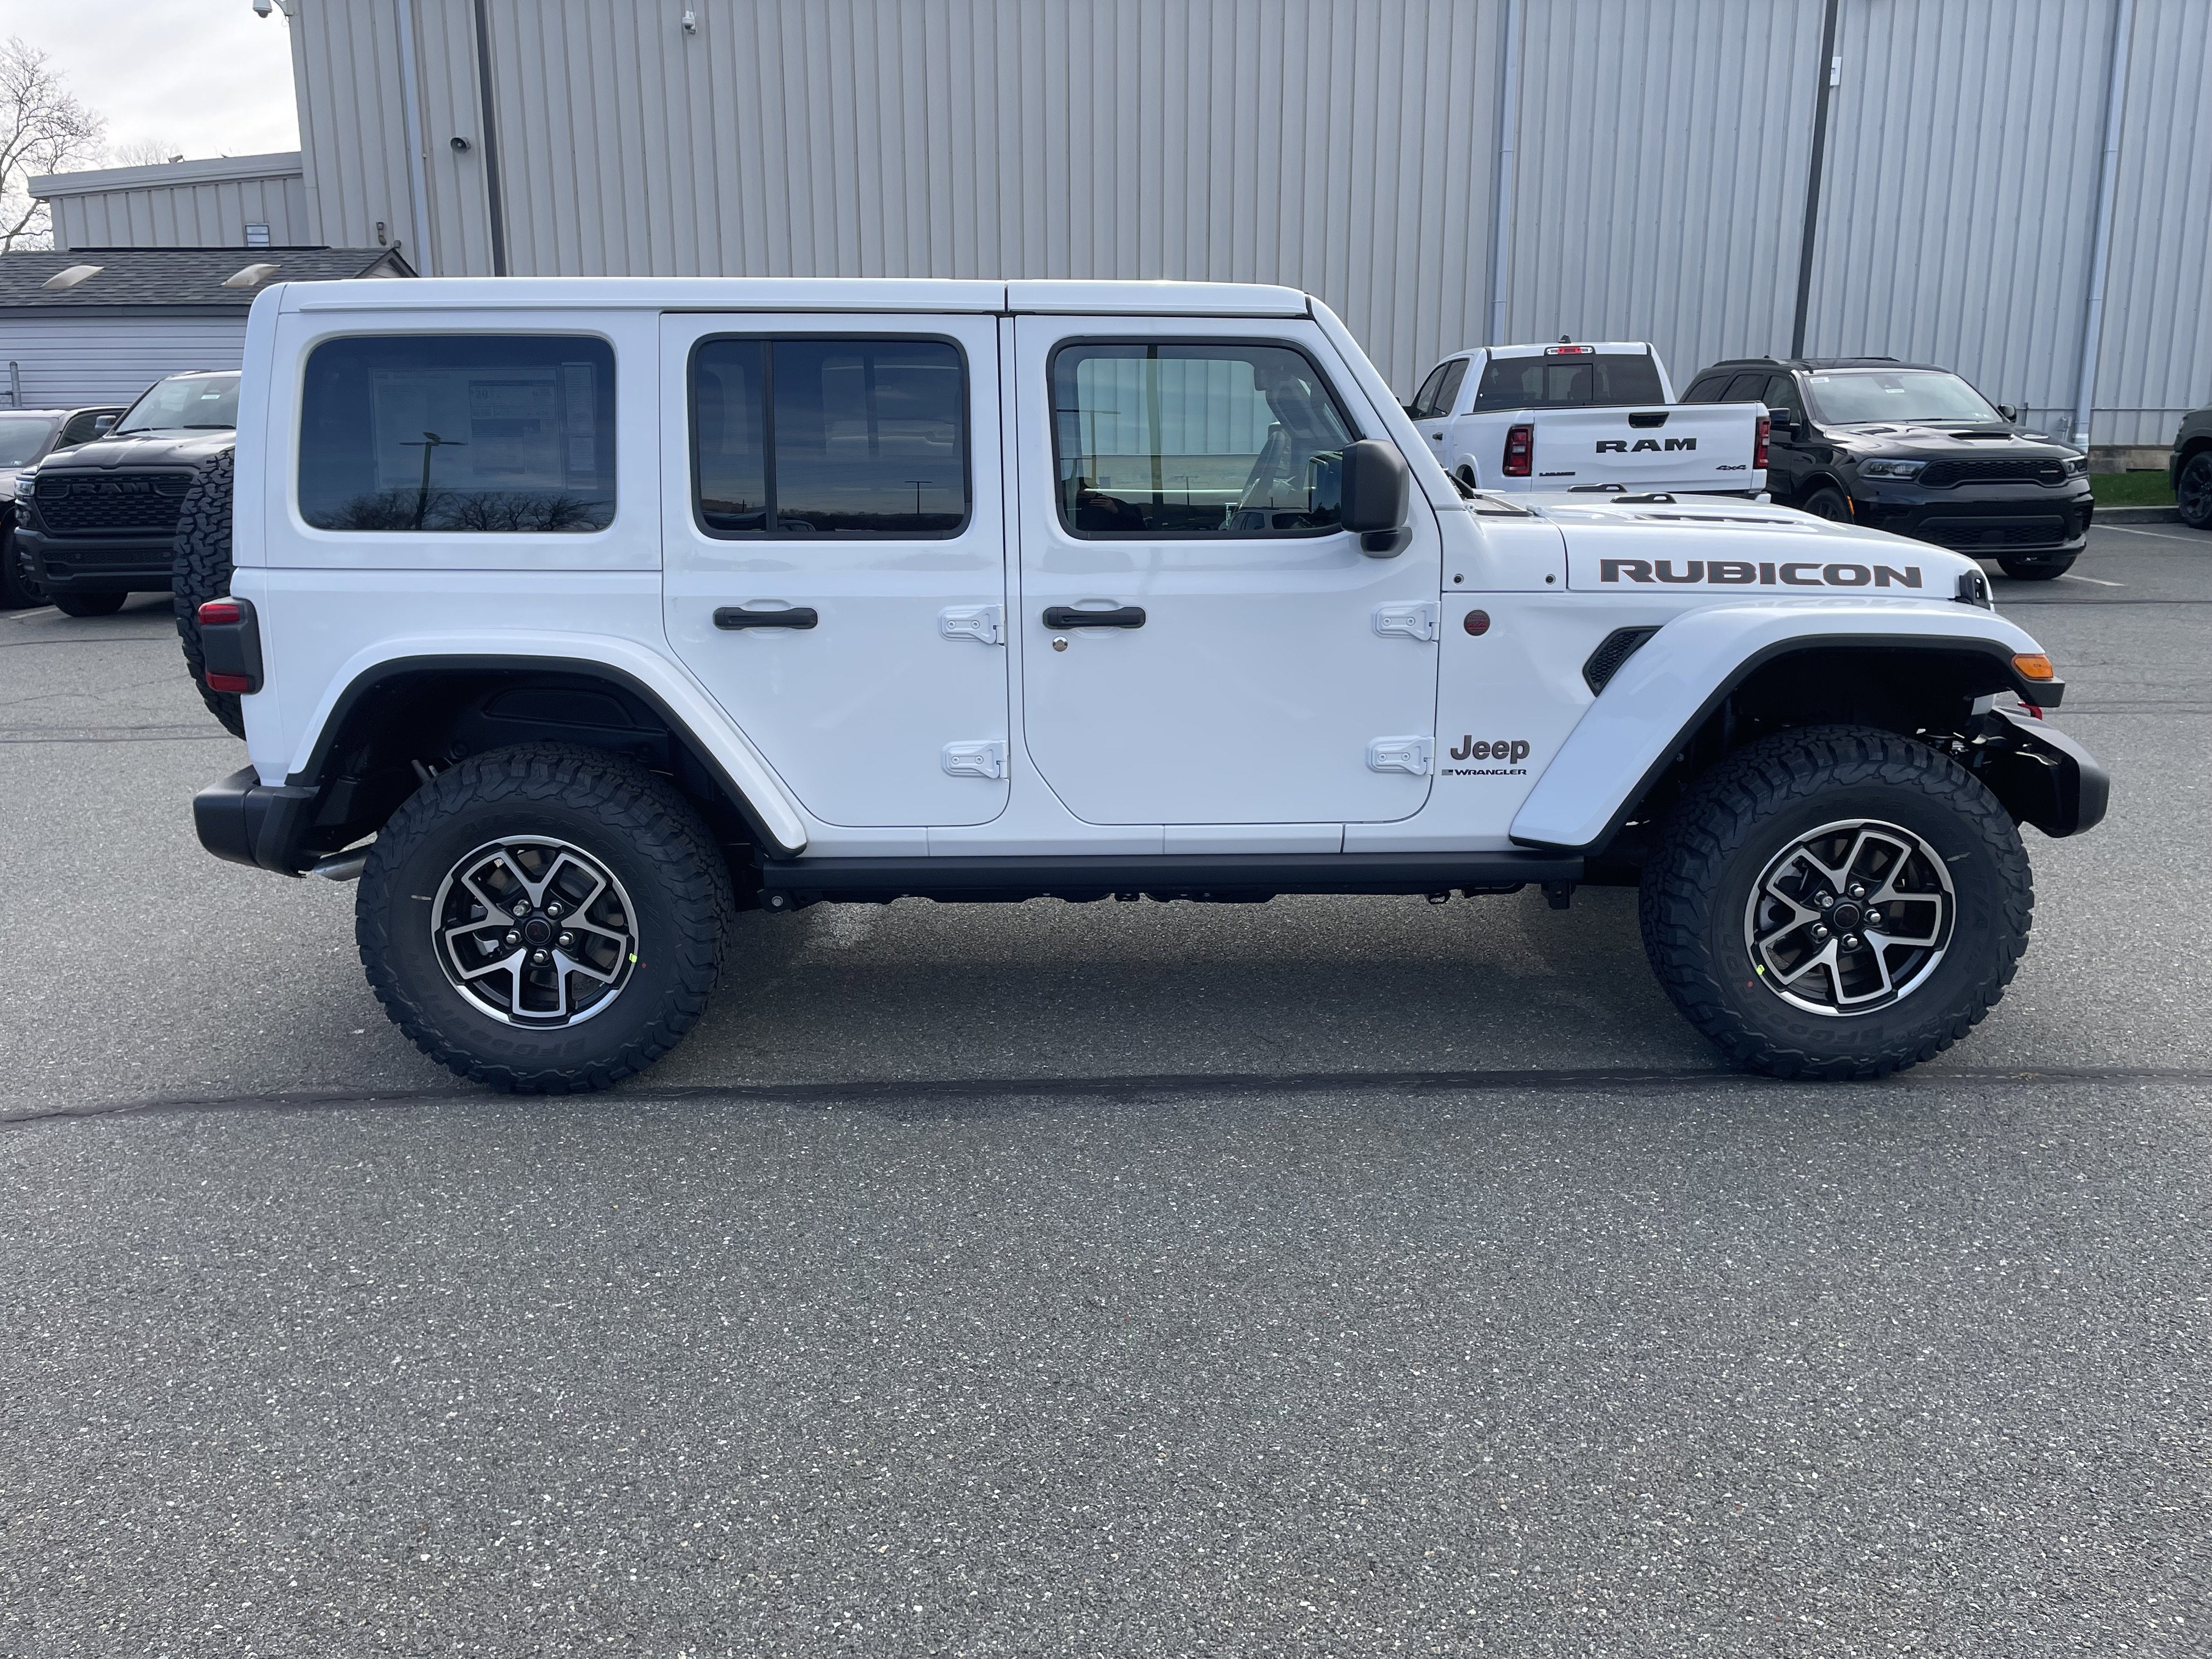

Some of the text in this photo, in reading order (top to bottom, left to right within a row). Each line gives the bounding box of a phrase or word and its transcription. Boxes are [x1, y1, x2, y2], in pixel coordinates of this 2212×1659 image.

[1596, 438, 1696, 453] RAM
[72, 483, 150, 494] RAM
[1600, 558, 1922, 588] RUBICON
[1451, 735, 1530, 764] Jeep
